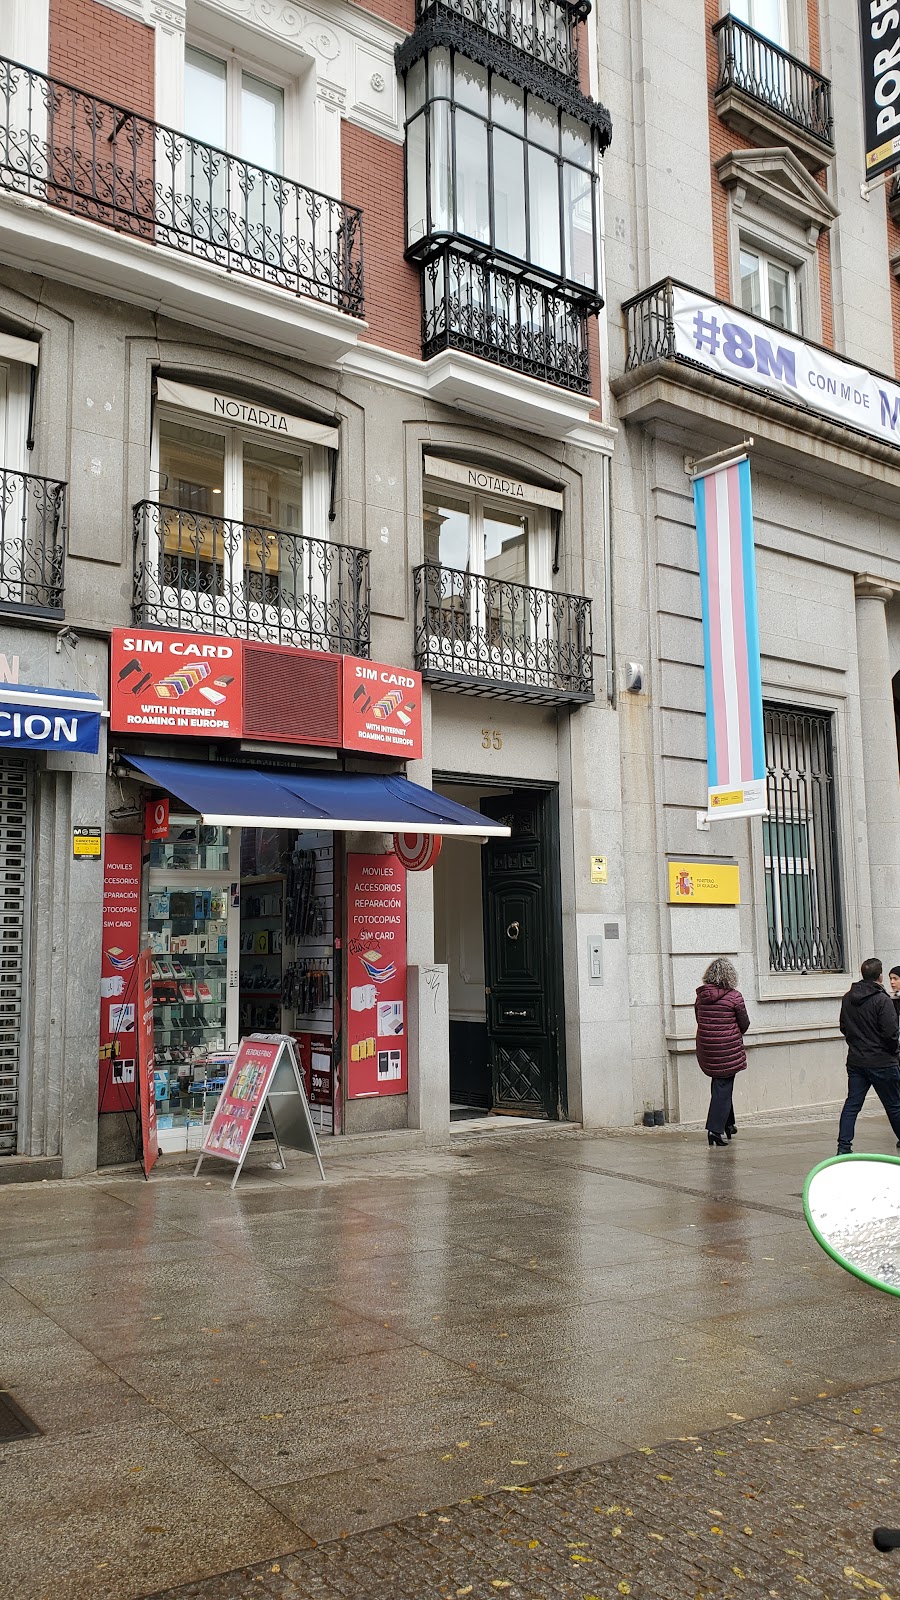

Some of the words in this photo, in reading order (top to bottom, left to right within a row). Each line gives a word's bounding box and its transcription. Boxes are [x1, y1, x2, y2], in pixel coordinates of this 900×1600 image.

[873, 37, 900, 136] POR
[693, 310, 798, 389] #8M
[807, 370, 837, 395] CON
[840, 382, 851, 402] M
[854, 389, 871, 409] DE
[213, 396, 288, 433] NOTARIA
[468, 470, 524, 498] NOTARIA
[122, 638, 163, 654] SIM
[169, 642, 233, 659] CARD
[355, 666, 377, 681] SIM
[380, 672, 415, 689] CARD
[140, 704, 168, 715] WITH
[169, 706, 217, 717] INTERNET
[127, 714, 176, 727] ROAMING
[177, 717, 189, 727] IN
[190, 718, 230, 729] EUROPE
[365, 722, 381, 733] WITH
[381, 725, 407, 737] INTERNET
[358, 730, 385, 743] ROAMING
[385, 735, 392, 744] IN
[392, 736, 414, 747] EUROPE
[481, 729, 503, 750] 35
[106, 863, 133, 871] MOVILES
[361, 867, 394, 877] MOVILES
[103, 877, 139, 885] CCESORIOS
[103, 890, 138, 899] EPARACIÓN
[354, 883, 402, 893] ACCESORIOS
[354, 897, 401, 909] REPARACIÓN
[102, 906, 138, 914] OTOCOPIAS
[103, 920, 114, 928] SIM
[115, 920, 132, 928] CARD
[353, 914, 401, 925] FOTOCOPIAS
[360, 931, 374, 941] SIM
[375, 931, 395, 941] CARD
